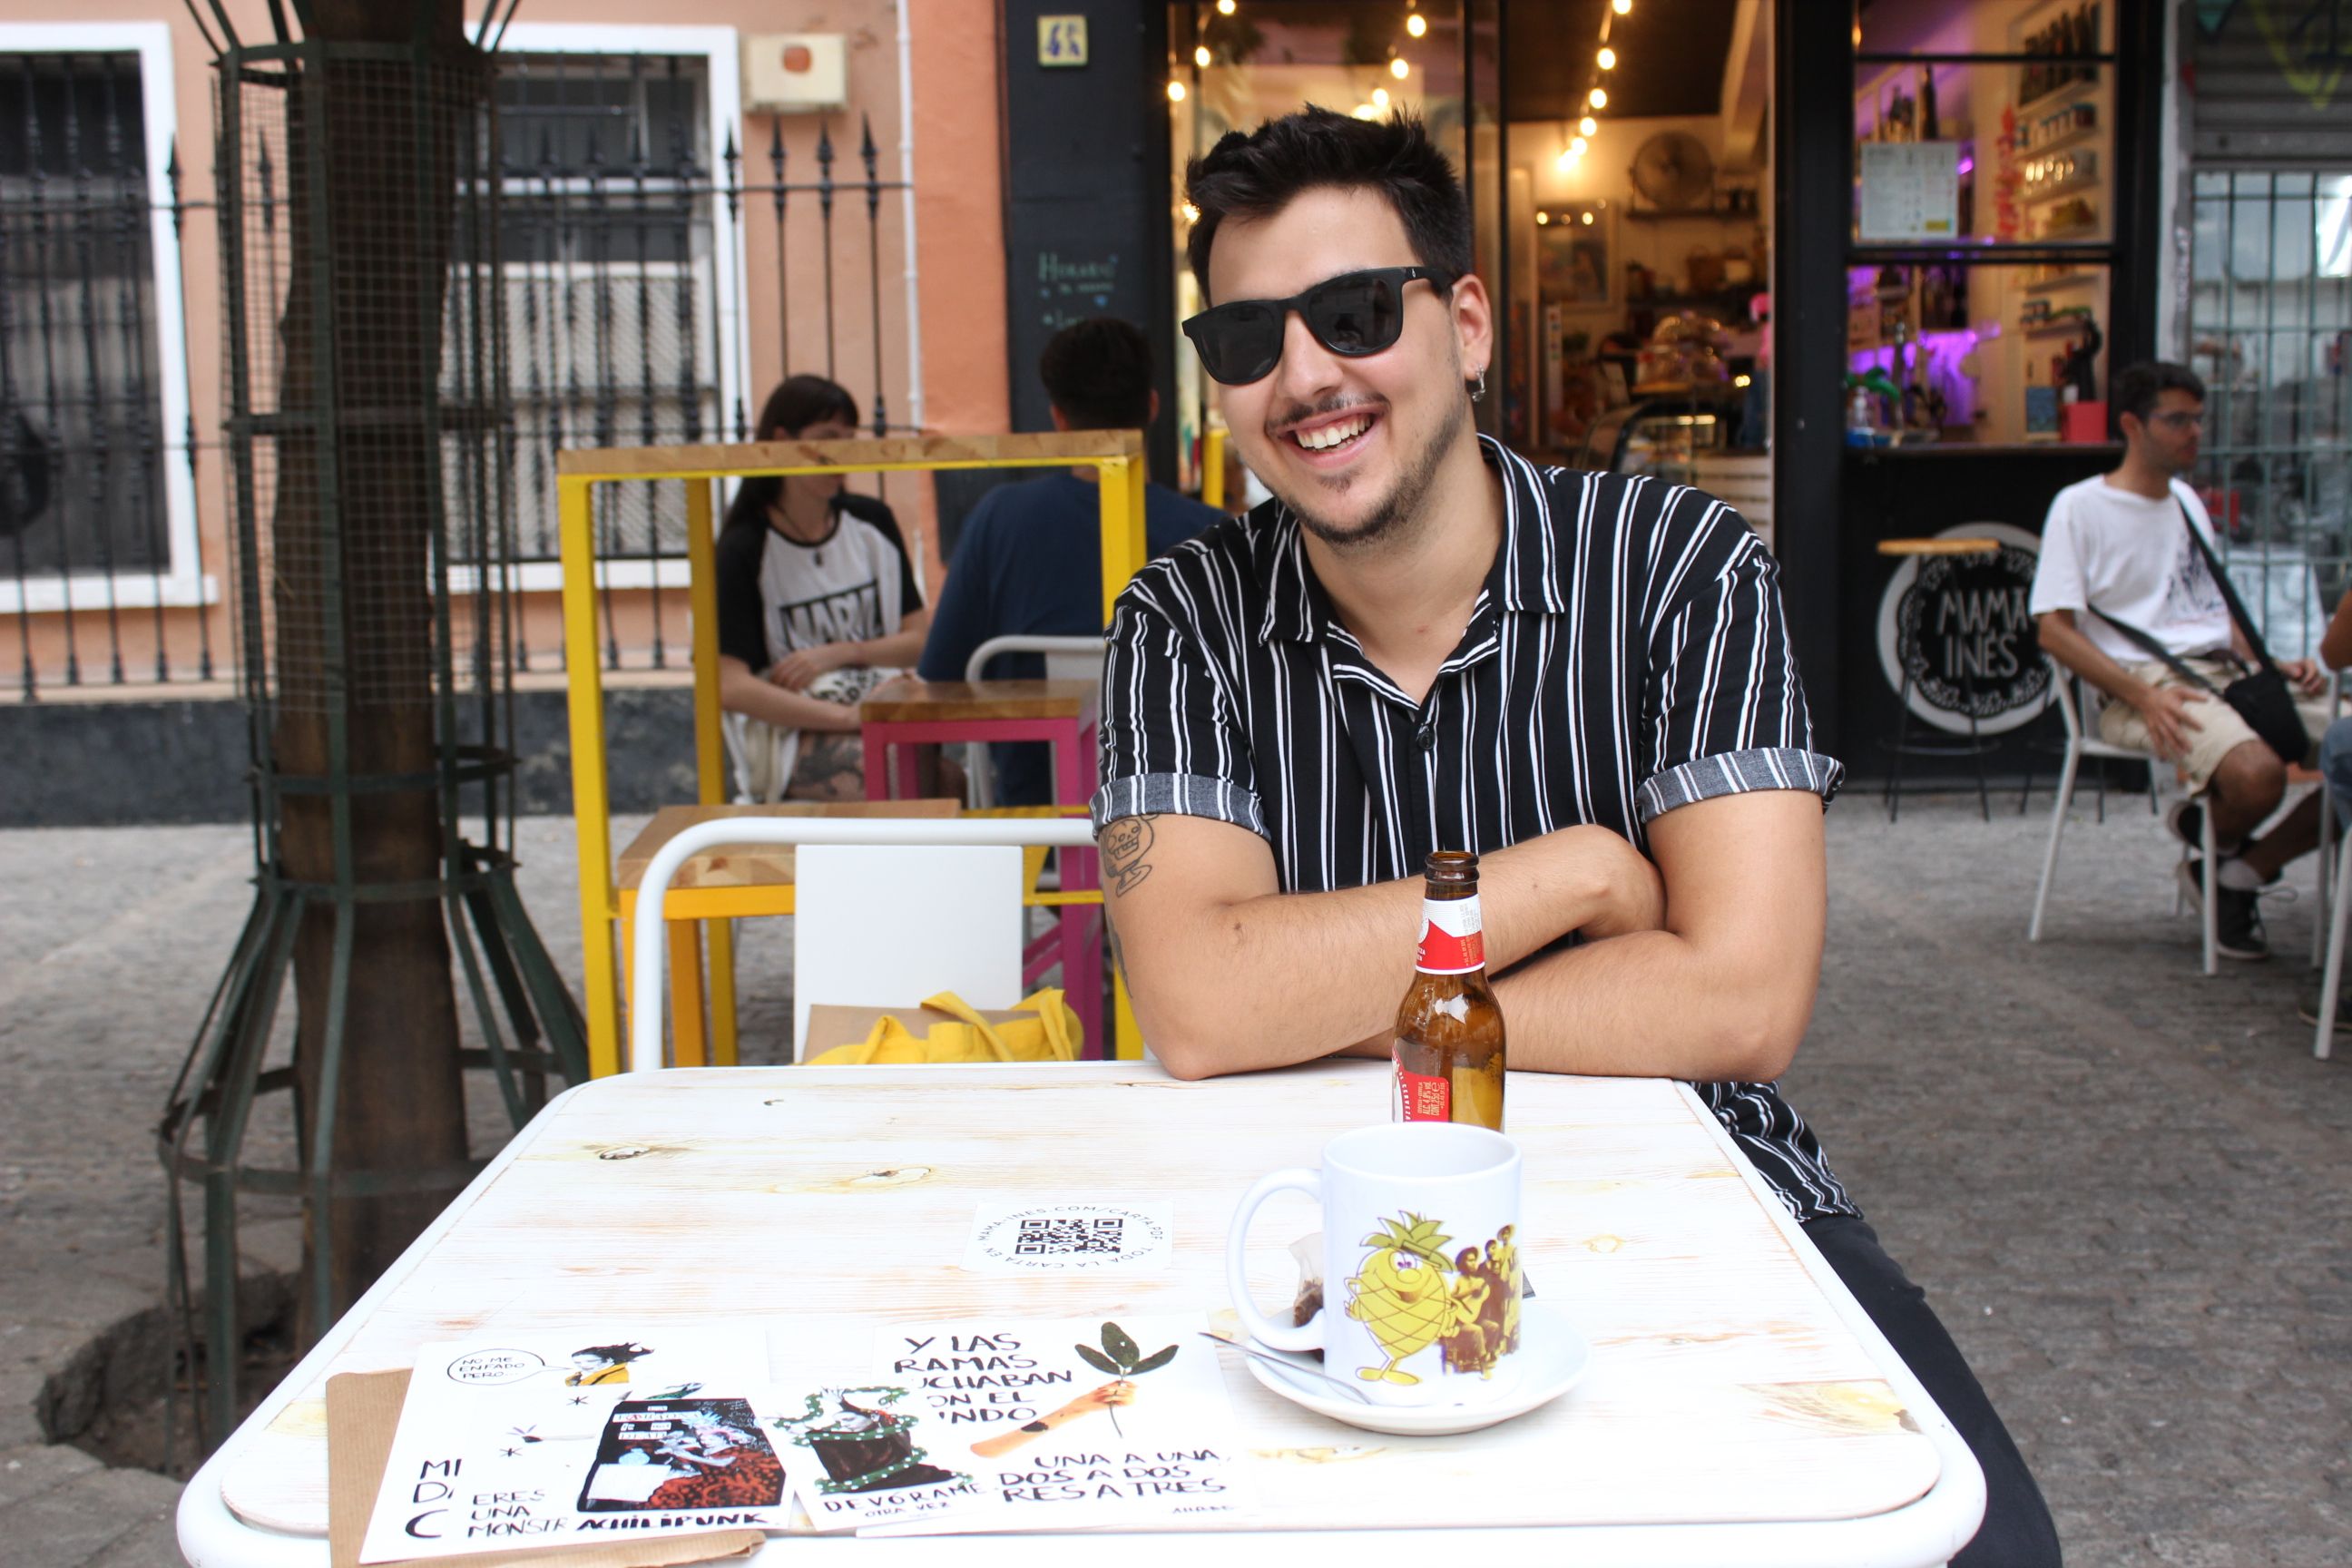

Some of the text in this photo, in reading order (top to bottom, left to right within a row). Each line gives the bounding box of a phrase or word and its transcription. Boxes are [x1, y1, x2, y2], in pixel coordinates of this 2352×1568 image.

[904, 1332, 1022, 1355] Y LAS
[459, 1362, 525, 1372] ENFADO
[894, 1353, 1038, 1374] RAMAS
[988, 1390, 1036, 1404] EL
[1034, 1453, 1112, 1469] UNA
[1124, 1453, 1147, 1464] A
[998, 1464, 1191, 1486] DOS A DOS
[1096, 1484, 1123, 1498] A
[1126, 1477, 1227, 1497] TRES
[473, 1489, 545, 1505] ERES
[471, 1504, 531, 1522] UNA
[865, 1506, 907, 1517] OTRA
[916, 1501, 952, 1511] VEZ
